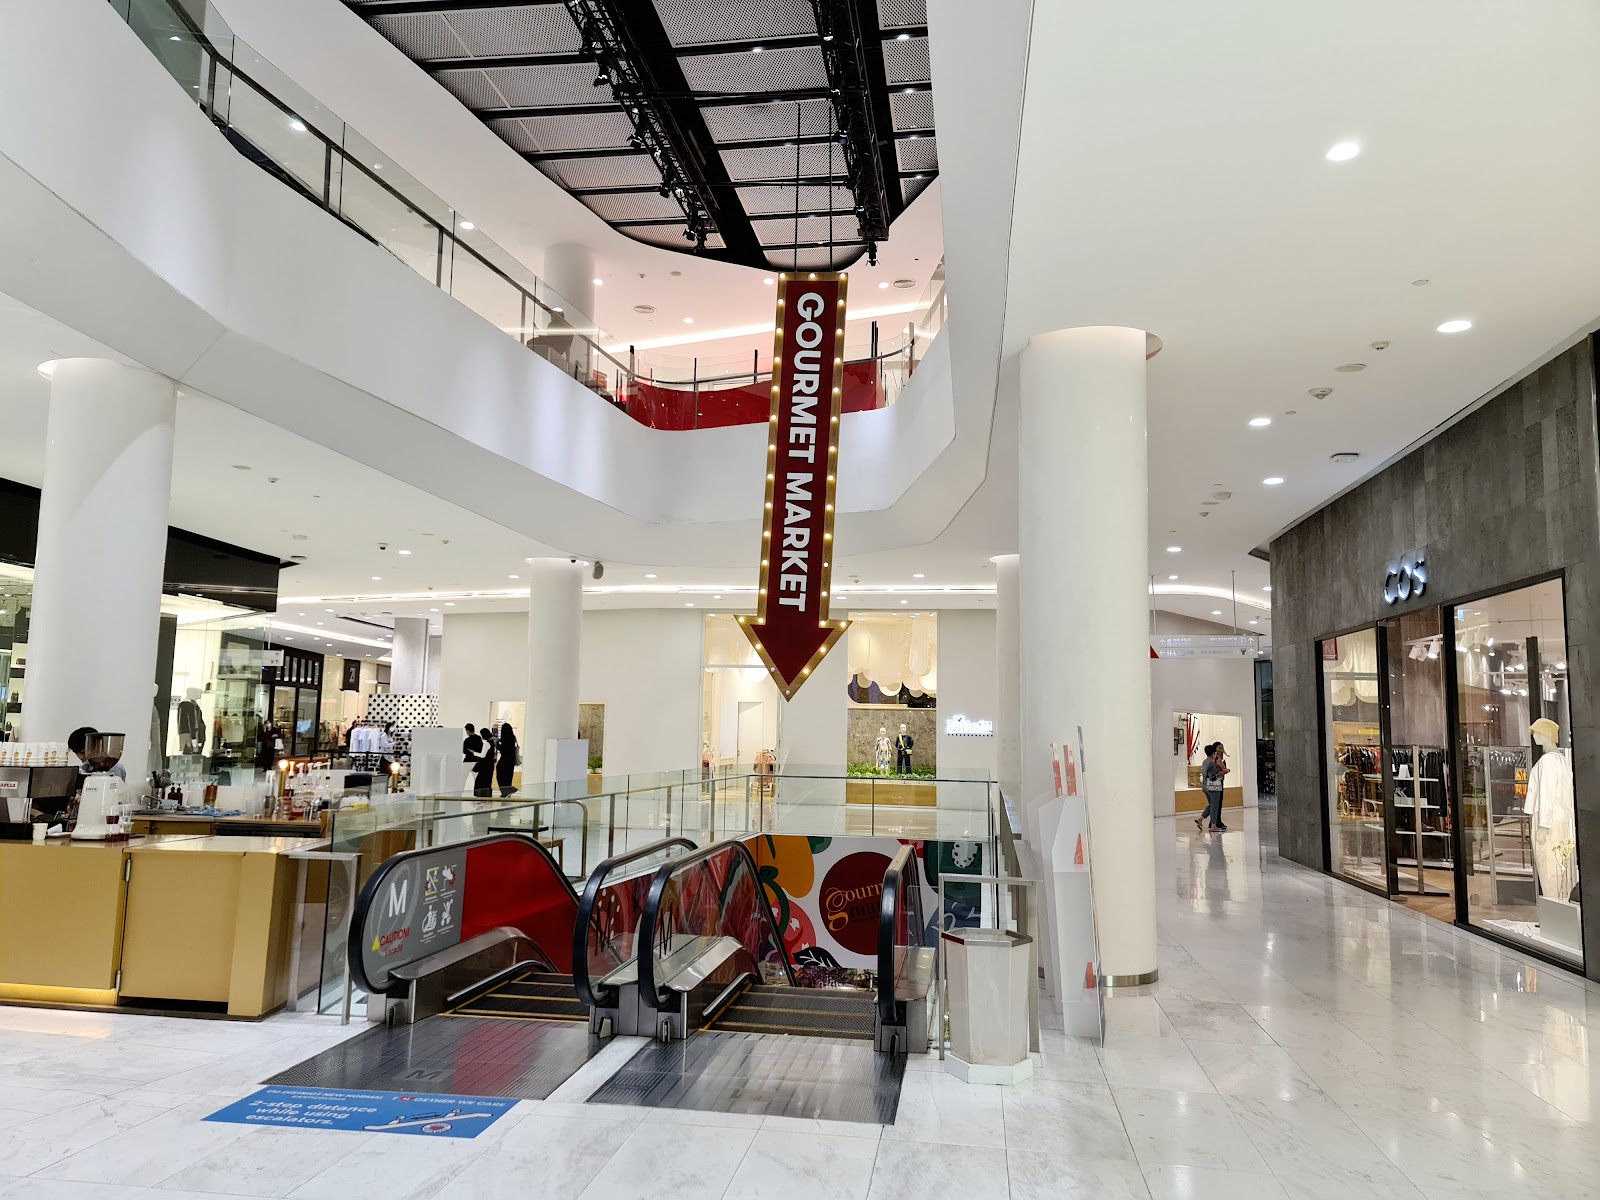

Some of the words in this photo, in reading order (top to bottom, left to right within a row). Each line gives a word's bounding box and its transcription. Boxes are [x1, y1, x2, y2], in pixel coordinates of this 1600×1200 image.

[788, 292, 825, 464] GOURMET
[779, 472, 813, 612] MARKET
[1383, 560, 1427, 605] COS
[388, 879, 408, 918] M
[405, 1069, 444, 1080] M
[246, 1113, 334, 1126] escalators.
[248, 1100, 303, 1109] 2-step
[307, 1103, 378, 1113] distance
[256, 1107, 300, 1115] while
[304, 1110, 350, 1119] using
